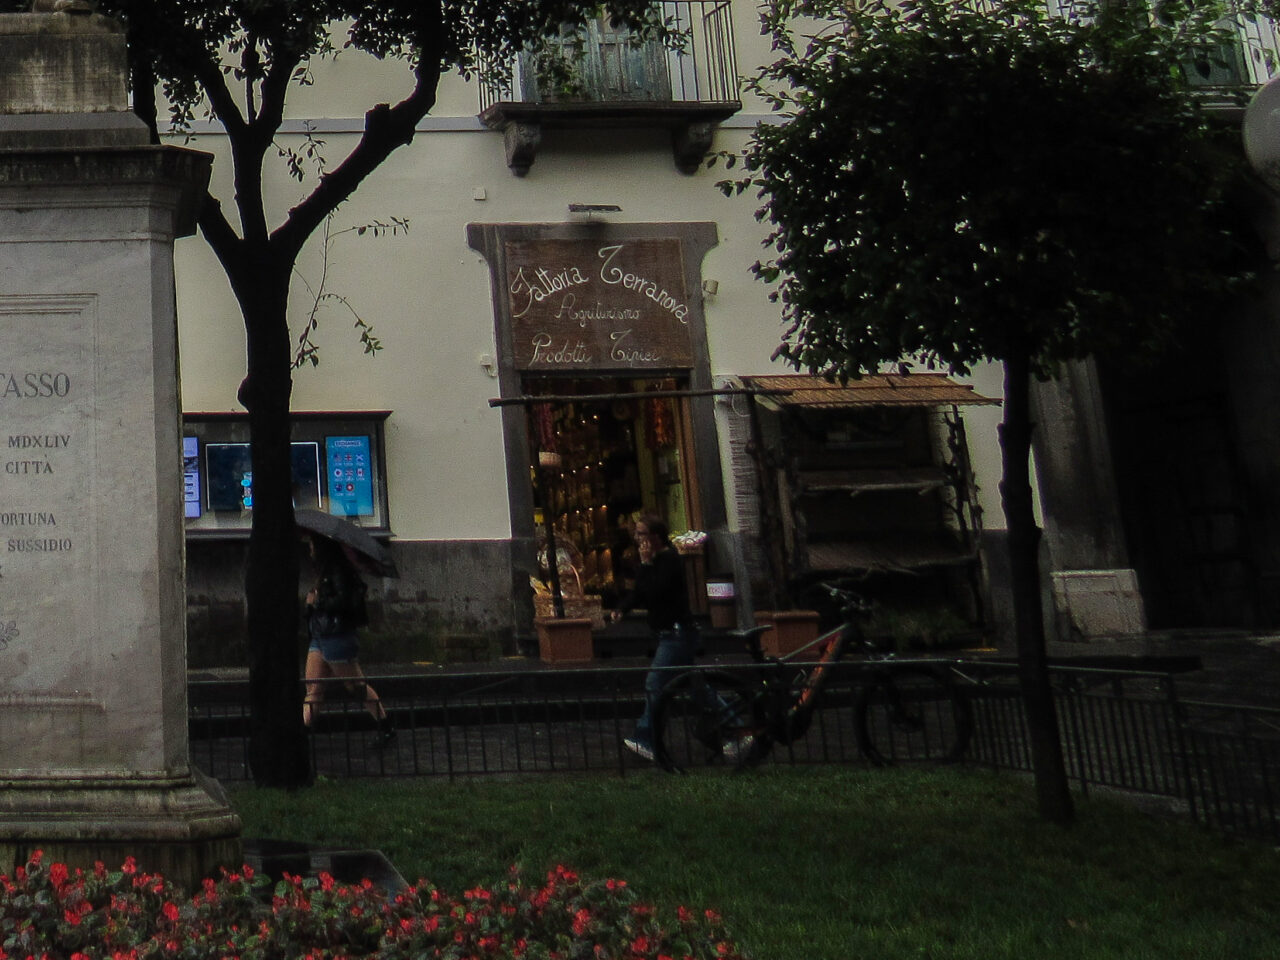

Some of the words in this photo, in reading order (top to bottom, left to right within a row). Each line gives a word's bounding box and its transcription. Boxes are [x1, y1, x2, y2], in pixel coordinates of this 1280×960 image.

[510, 267, 589, 318] Fattoria
[598, 244, 689, 324] Terranova
[554, 293, 641, 328] Agriturismo
[528, 332, 593, 367] Prodotti
[610, 329, 661, 367] Tipici
[8, 435, 70, 449] MDXLIV
[5, 454, 54, 474] CITTÀ
[7, 538, 72, 552] SUSSIDIO
